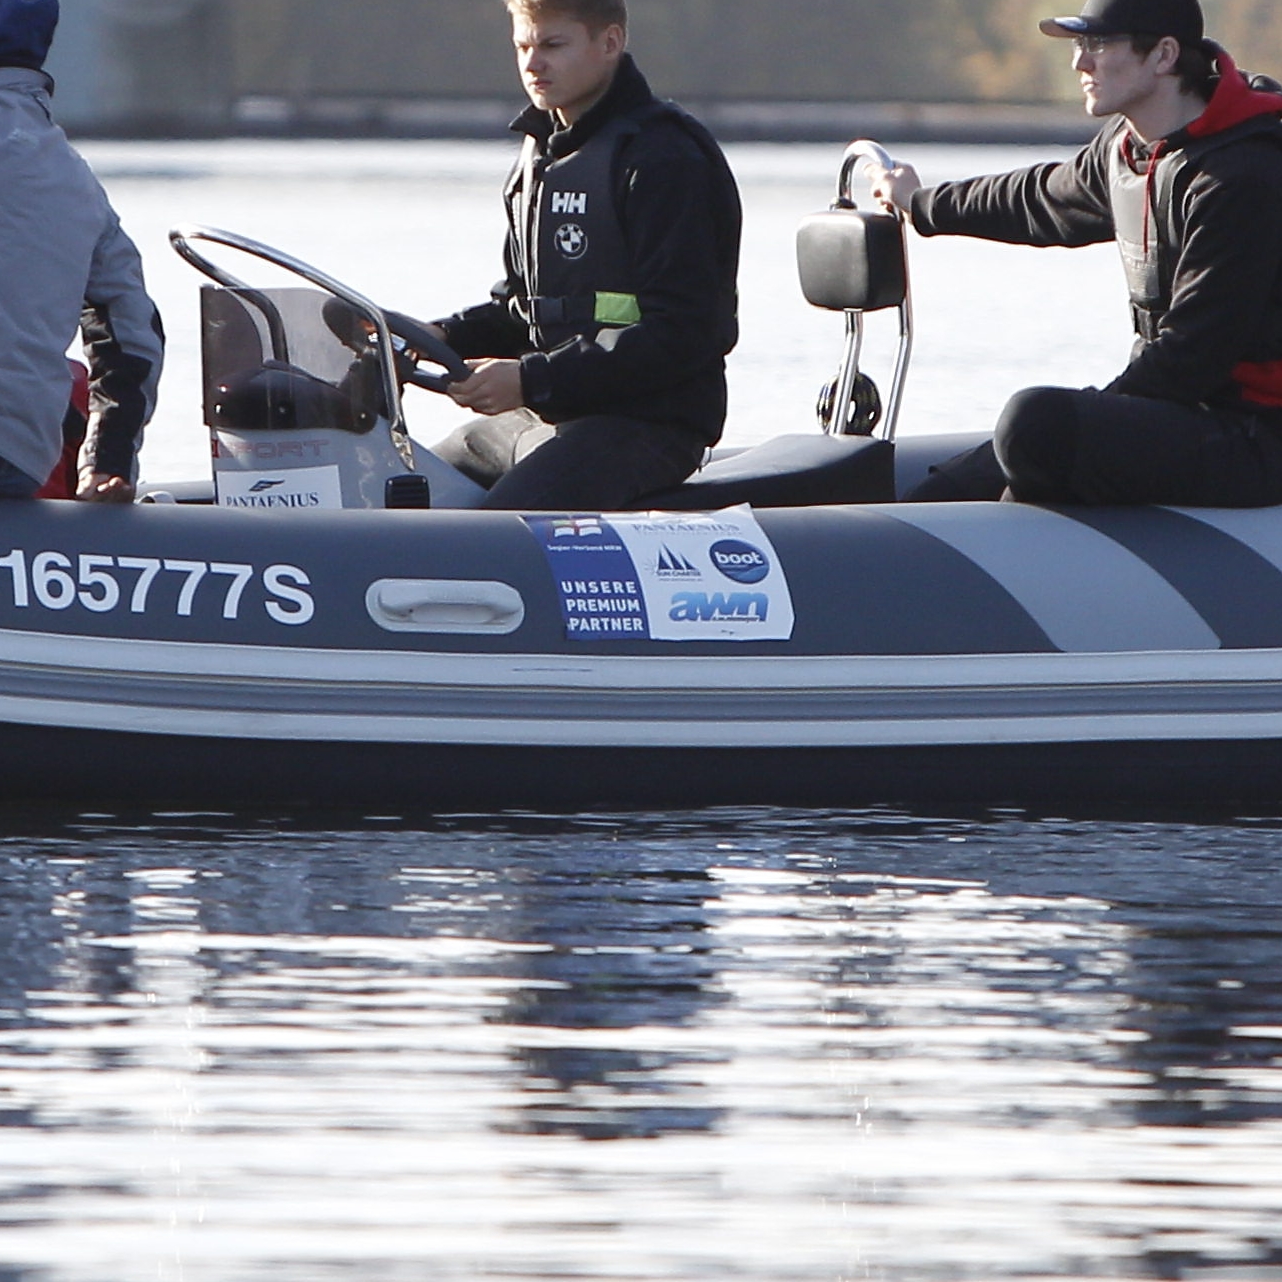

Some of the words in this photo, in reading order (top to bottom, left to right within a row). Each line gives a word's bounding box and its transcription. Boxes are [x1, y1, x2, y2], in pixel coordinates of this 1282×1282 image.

[552, 192, 587, 214] HH
[714, 551, 764, 565] boot
[562, 581, 637, 594] UNSERE
[566, 599, 640, 612] PREMIUM
[669, 591, 769, 622] awn
[570, 617, 644, 632] PARTNER
